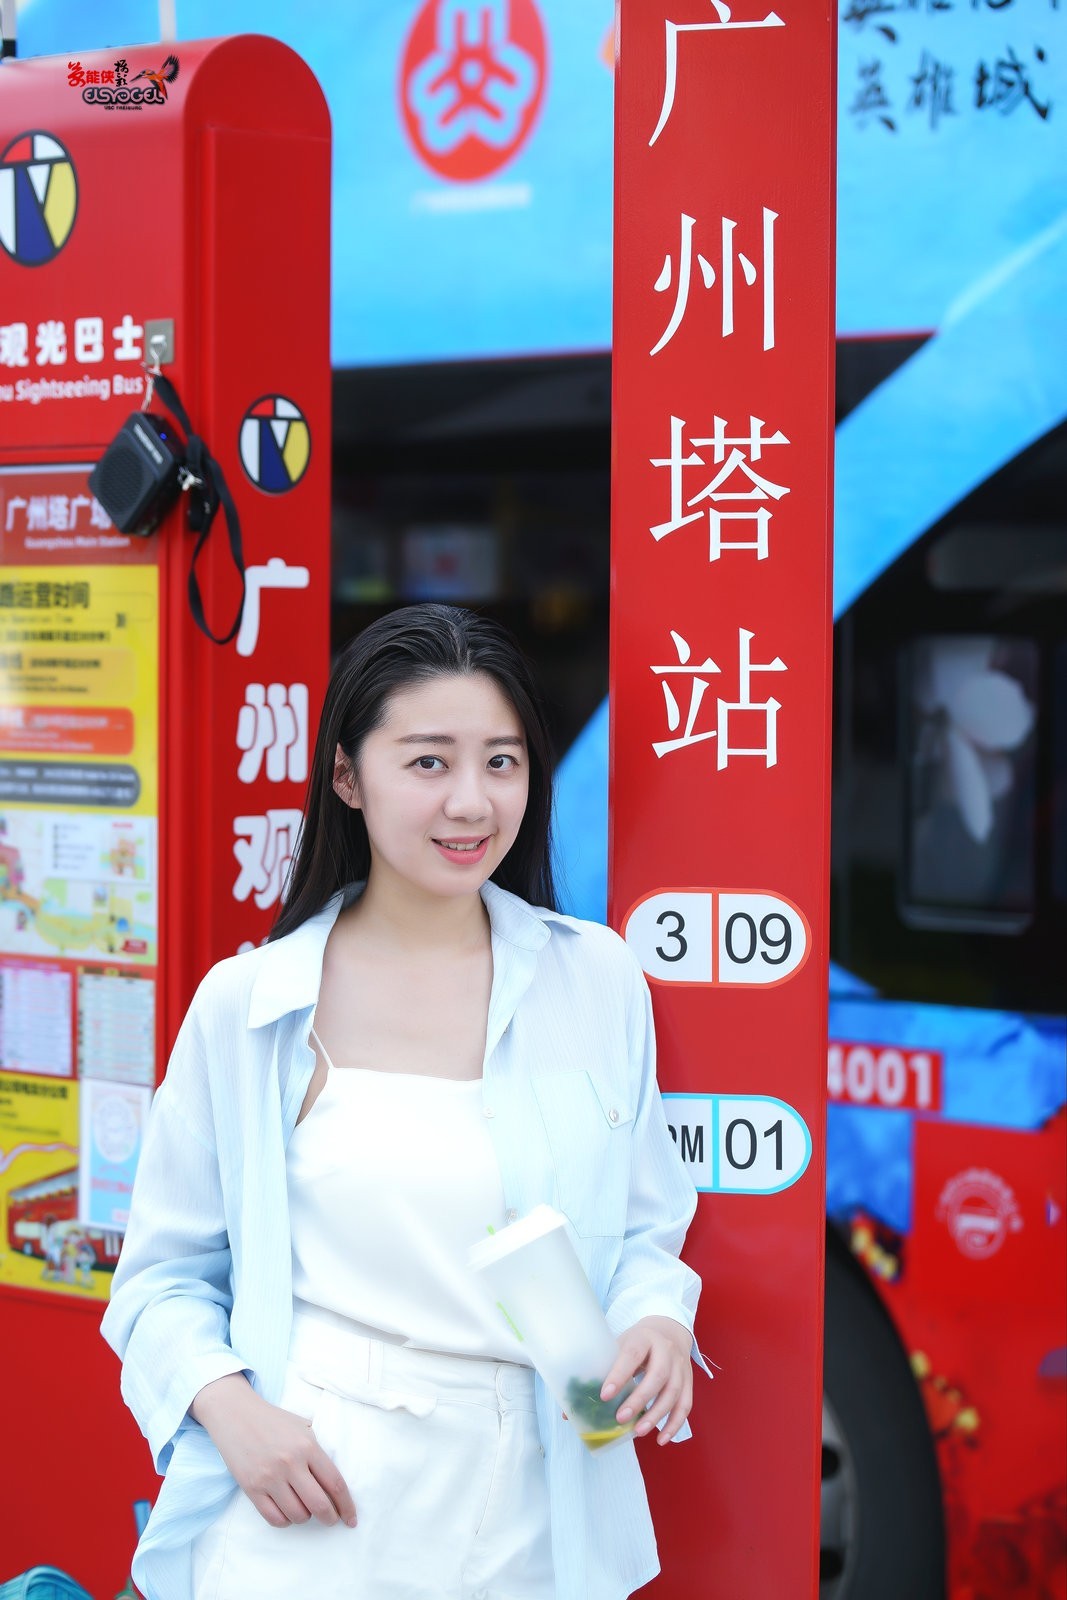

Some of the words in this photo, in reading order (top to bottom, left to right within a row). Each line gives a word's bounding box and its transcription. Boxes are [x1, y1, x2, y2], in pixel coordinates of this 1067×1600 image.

[0, 315, 144, 367] 观光巴士
[15, 374, 110, 404] Sightseeing
[113, 374, 143, 396] Bus
[649, 0, 791, 770] 广州塔站
[232, 557, 310, 955] 广州观
[655, 911, 688, 962] 3
[725, 912, 792, 965] 09
[725, 1118, 783, 1170] 01
